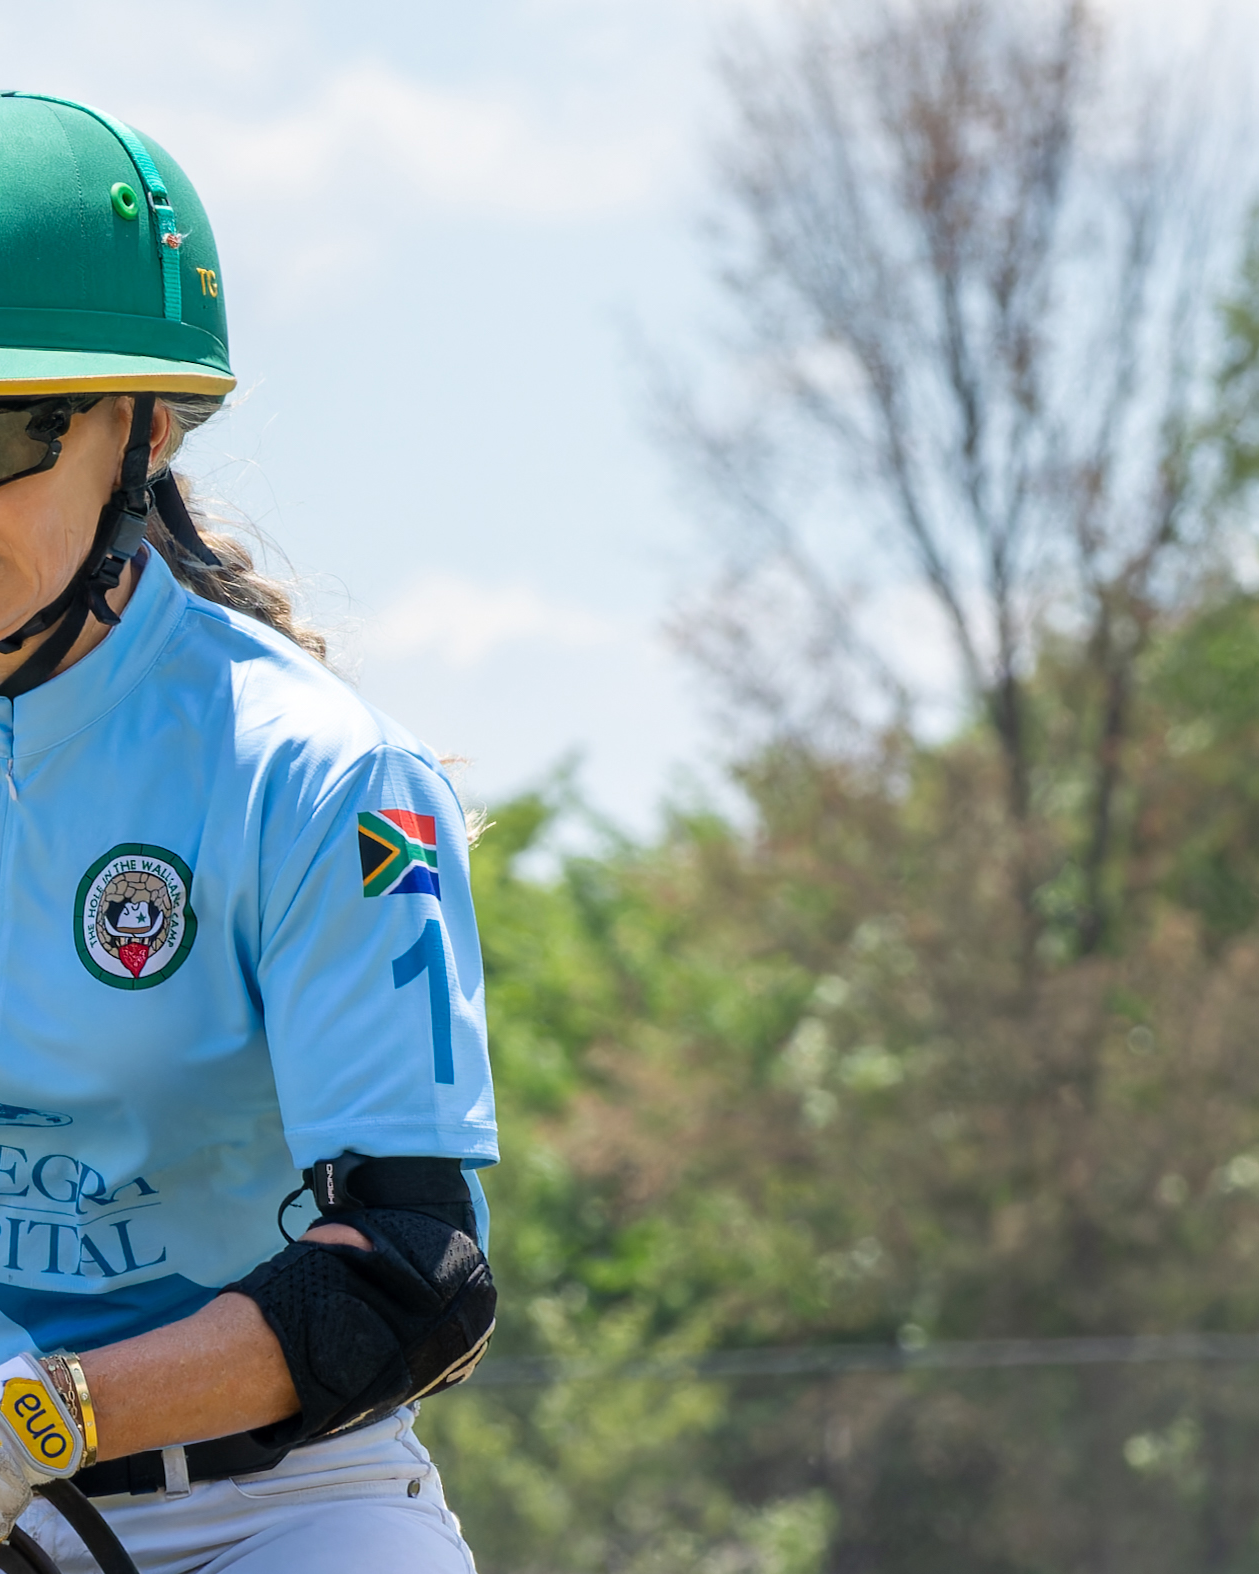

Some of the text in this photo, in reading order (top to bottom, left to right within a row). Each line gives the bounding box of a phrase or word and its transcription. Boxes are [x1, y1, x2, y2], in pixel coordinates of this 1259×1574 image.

[196, 267, 218, 298] TG
[102, 870, 113, 885] IN
[113, 860, 137, 873] THE
[142, 860, 171, 881] WALL
[88, 885, 103, 918] HOLE
[87, 924, 98, 949] THE
[168, 912, 179, 948] CAMP
[391, 918, 455, 1085] 1
[14, 1392, 67, 1459] ona
